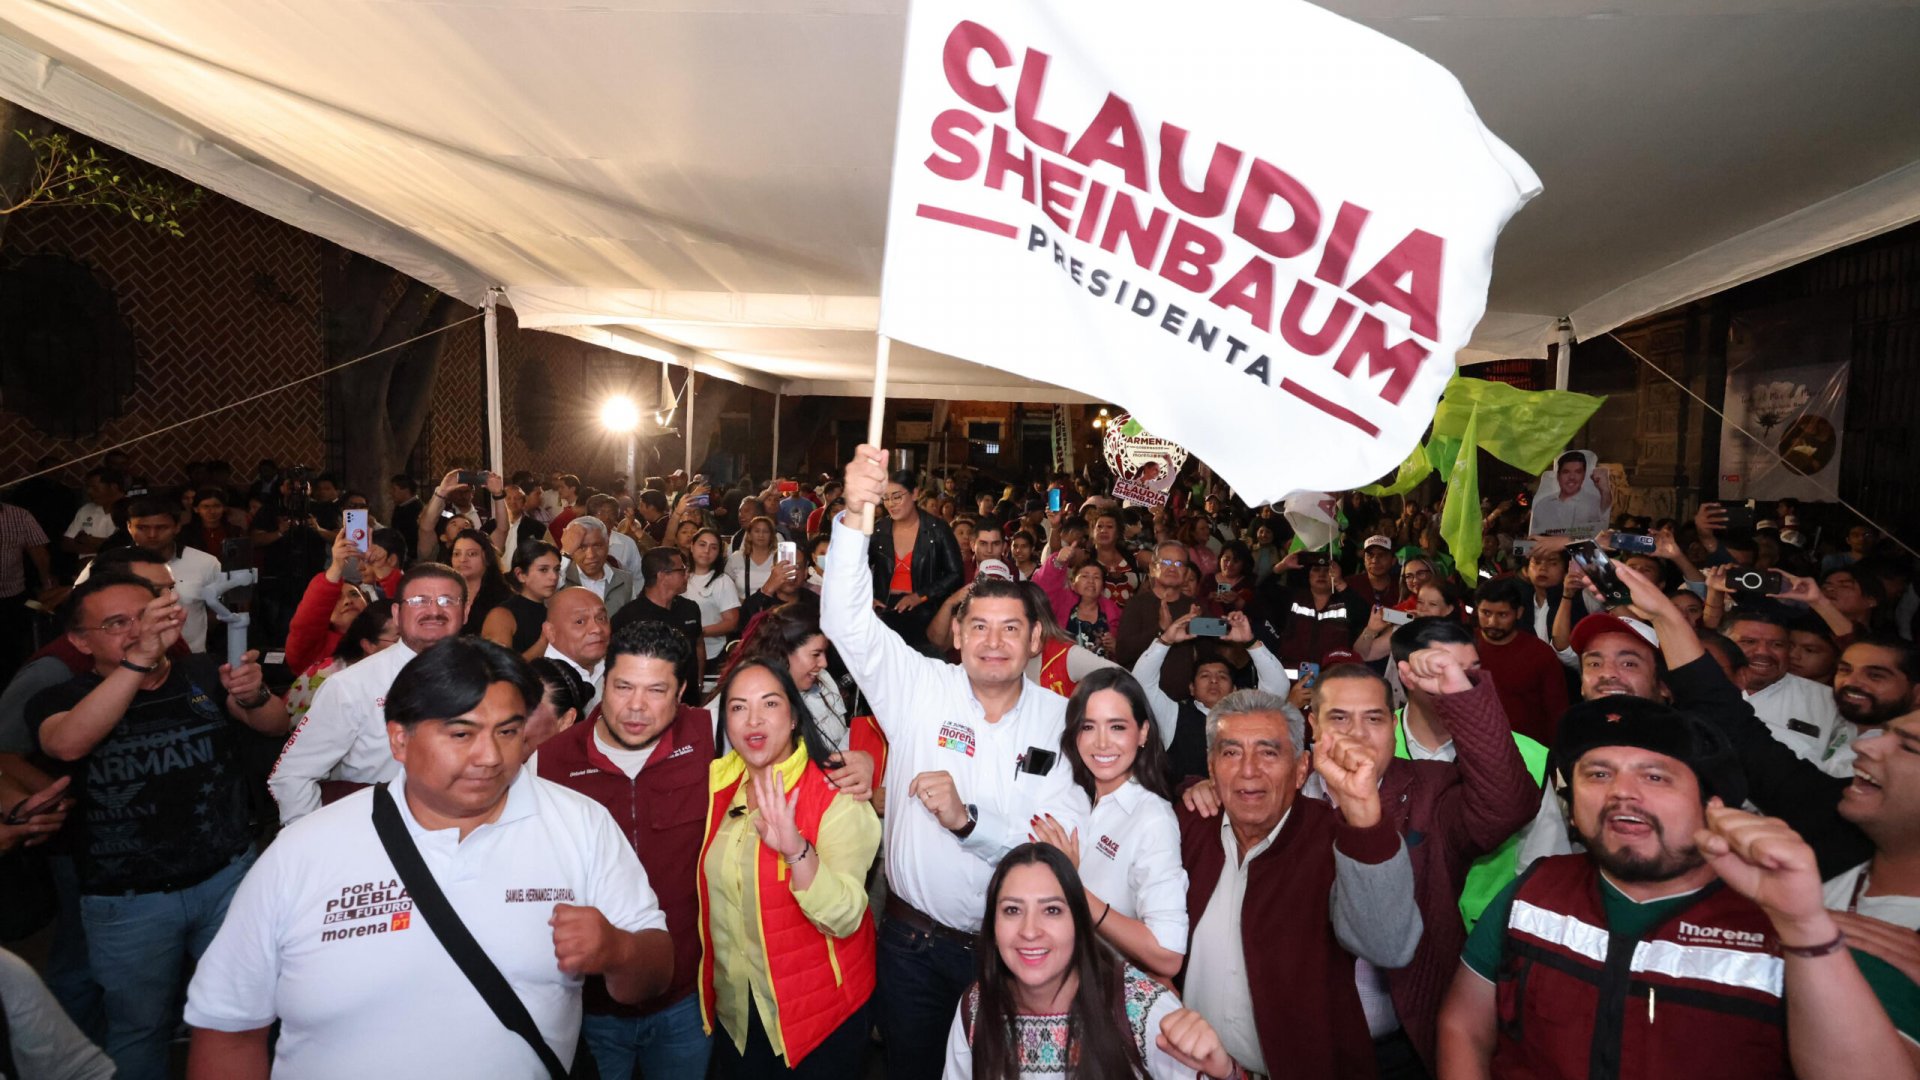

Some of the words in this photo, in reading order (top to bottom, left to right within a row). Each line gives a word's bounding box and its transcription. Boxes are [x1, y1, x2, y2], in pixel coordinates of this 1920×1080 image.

[942, 19, 1447, 342] CLAUDIA
[923, 108, 1431, 406] SHEINBAUM
[1026, 224, 1271, 386] PRESIDENTA
[1117, 482, 1166, 502] CLAUDIA
[281, 716, 308, 754] CLAUDIA
[940, 727, 975, 747] morena
[87, 736, 214, 784] ARMANI
[326, 887, 411, 913] PUEBLA
[341, 882, 374, 897] POR
[379, 879, 398, 890] LA
[325, 911, 352, 924] DEL
[355, 901, 411, 918] FUTURO
[321, 922, 388, 942] morena
[392, 918, 409, 931] PT
[1679, 920, 1764, 942] morena
